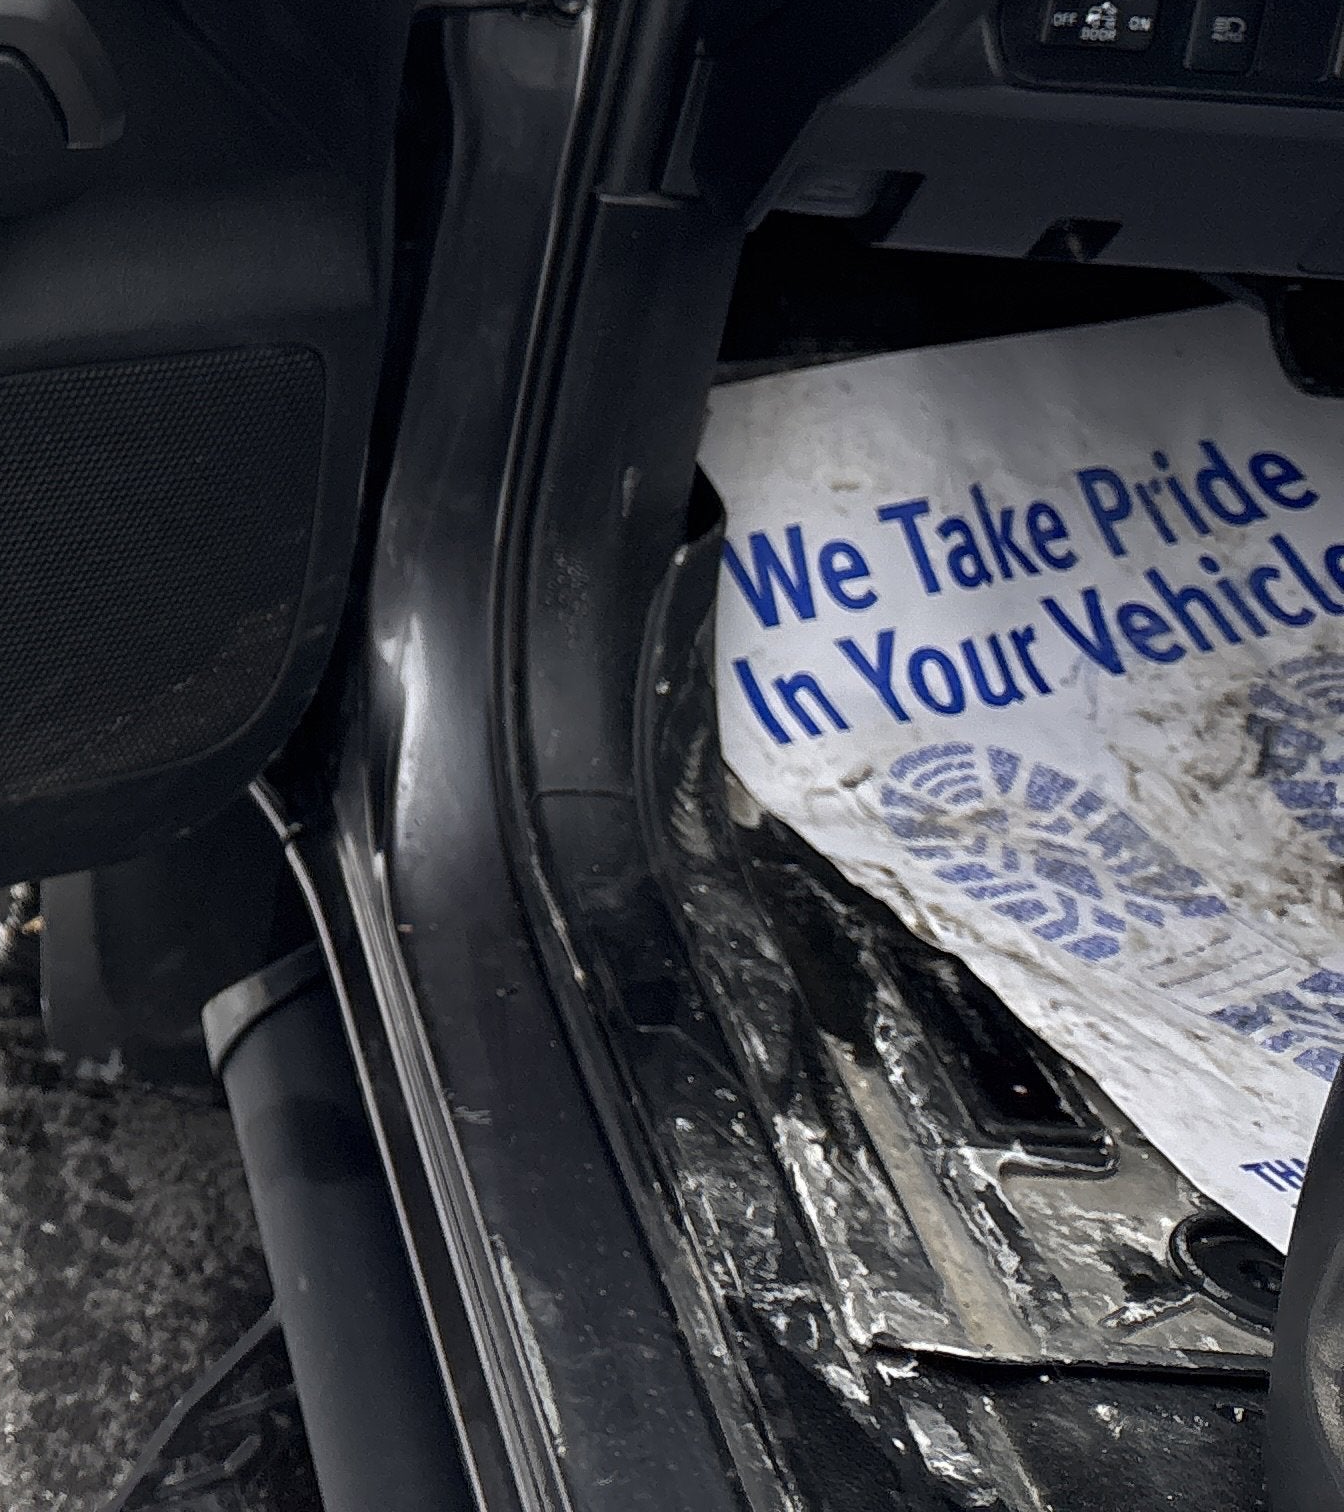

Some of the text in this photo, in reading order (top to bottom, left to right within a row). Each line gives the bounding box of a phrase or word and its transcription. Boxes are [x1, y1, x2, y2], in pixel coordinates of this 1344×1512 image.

[1053, 12, 1078, 27] OFF
[1128, 16, 1151, 31] ON
[1080, 26, 1117, 41] DOOR
[722, 439, 1319, 630] We Take Pride
[732, 657, 849, 746] In
[835, 622, 1053, 724] Your
